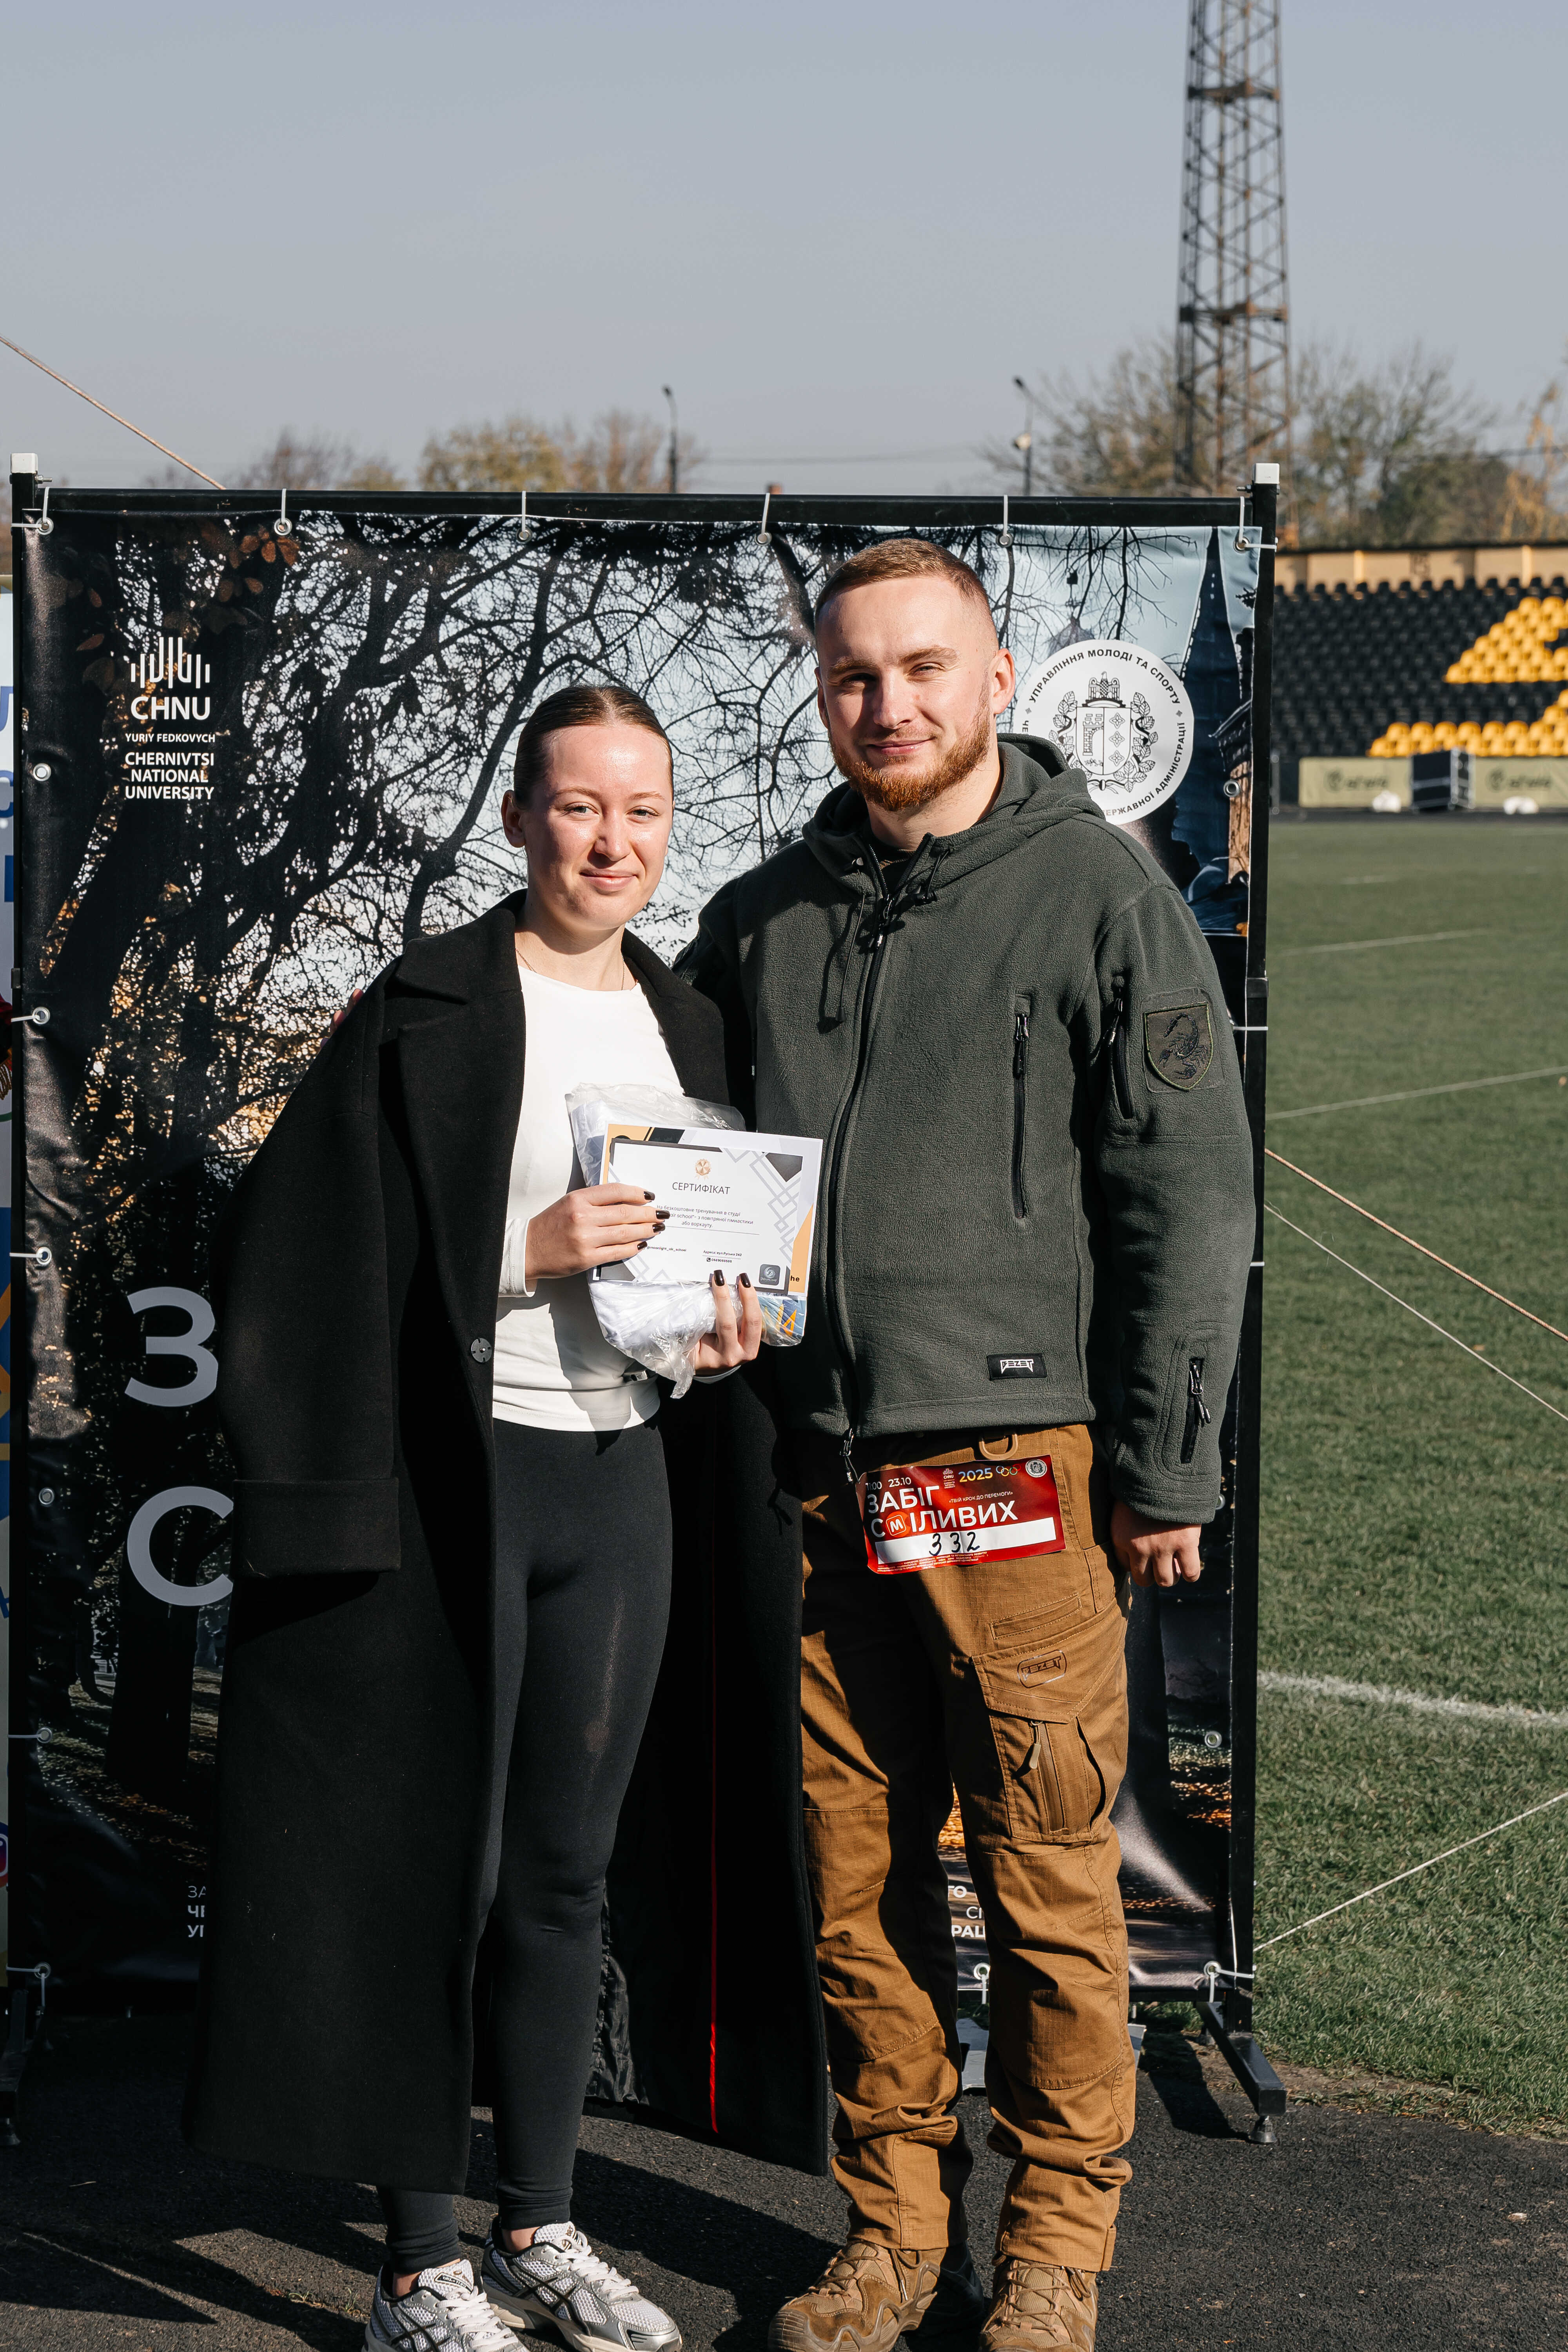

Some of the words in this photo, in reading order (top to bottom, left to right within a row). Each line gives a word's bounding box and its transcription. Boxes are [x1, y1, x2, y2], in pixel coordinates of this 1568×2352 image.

[1029, 653, 1085, 703] УПРАВЛІННЯ
[1087, 649, 1132, 661] МОЛОДІ
[1136, 657, 1149, 670] ТА
[1150, 667, 1180, 705] СПОРТУ
[131, 697, 210, 720] CHNU
[125, 733, 154, 742] YURIY
[157, 734, 215, 742] FEDKOVYCH
[125, 752, 214, 766] CHERNIVTSI
[131, 769, 209, 782] NATIONAL
[1103, 791, 1154, 816] ЕРЖАВНОЇ
[1155, 722, 1185, 794] АДМІНІСТРАЦІЇ
[125, 786, 214, 799] UNIVERSITY
[672, 1182, 730, 1194] СЕРТИФІКАТ
[958, 1468, 993, 1482] 2025
[866, 1482, 882, 1490] 11:00
[888, 1477, 911, 1487] 23.10
[867, 1485, 940, 1514] ЗАБІГ
